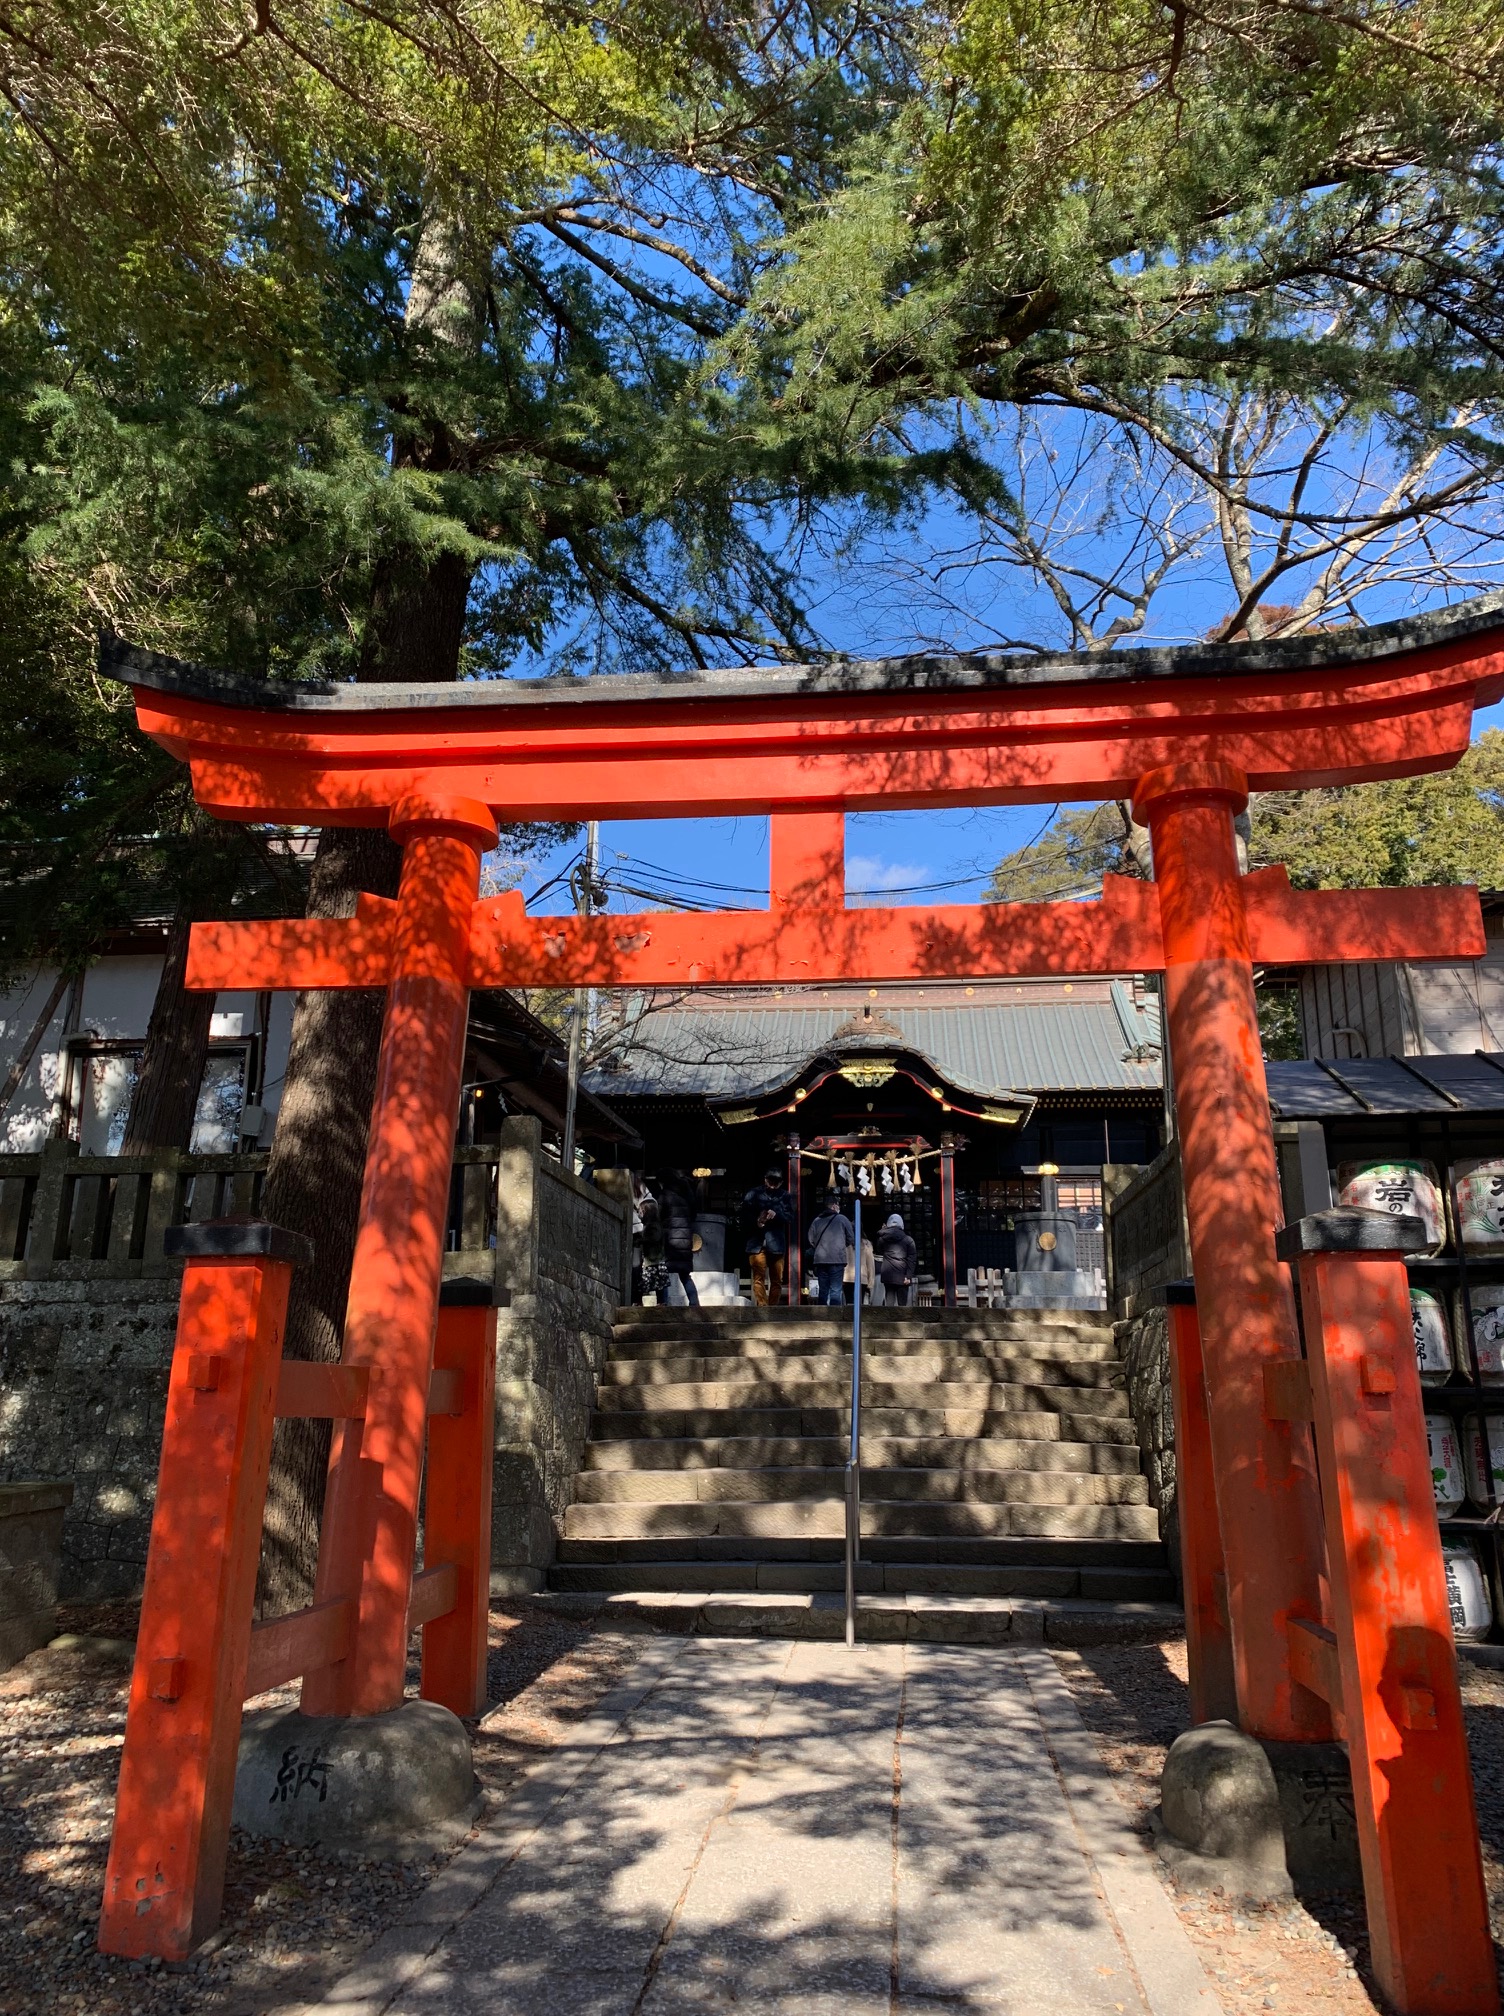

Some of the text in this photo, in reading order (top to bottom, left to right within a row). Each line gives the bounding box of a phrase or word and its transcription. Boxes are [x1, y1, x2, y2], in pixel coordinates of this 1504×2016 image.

[1375, 1178, 1414, 1216] 岩の
[268, 1745, 335, 1804] 納
[1299, 1769, 1357, 1841] 奉
